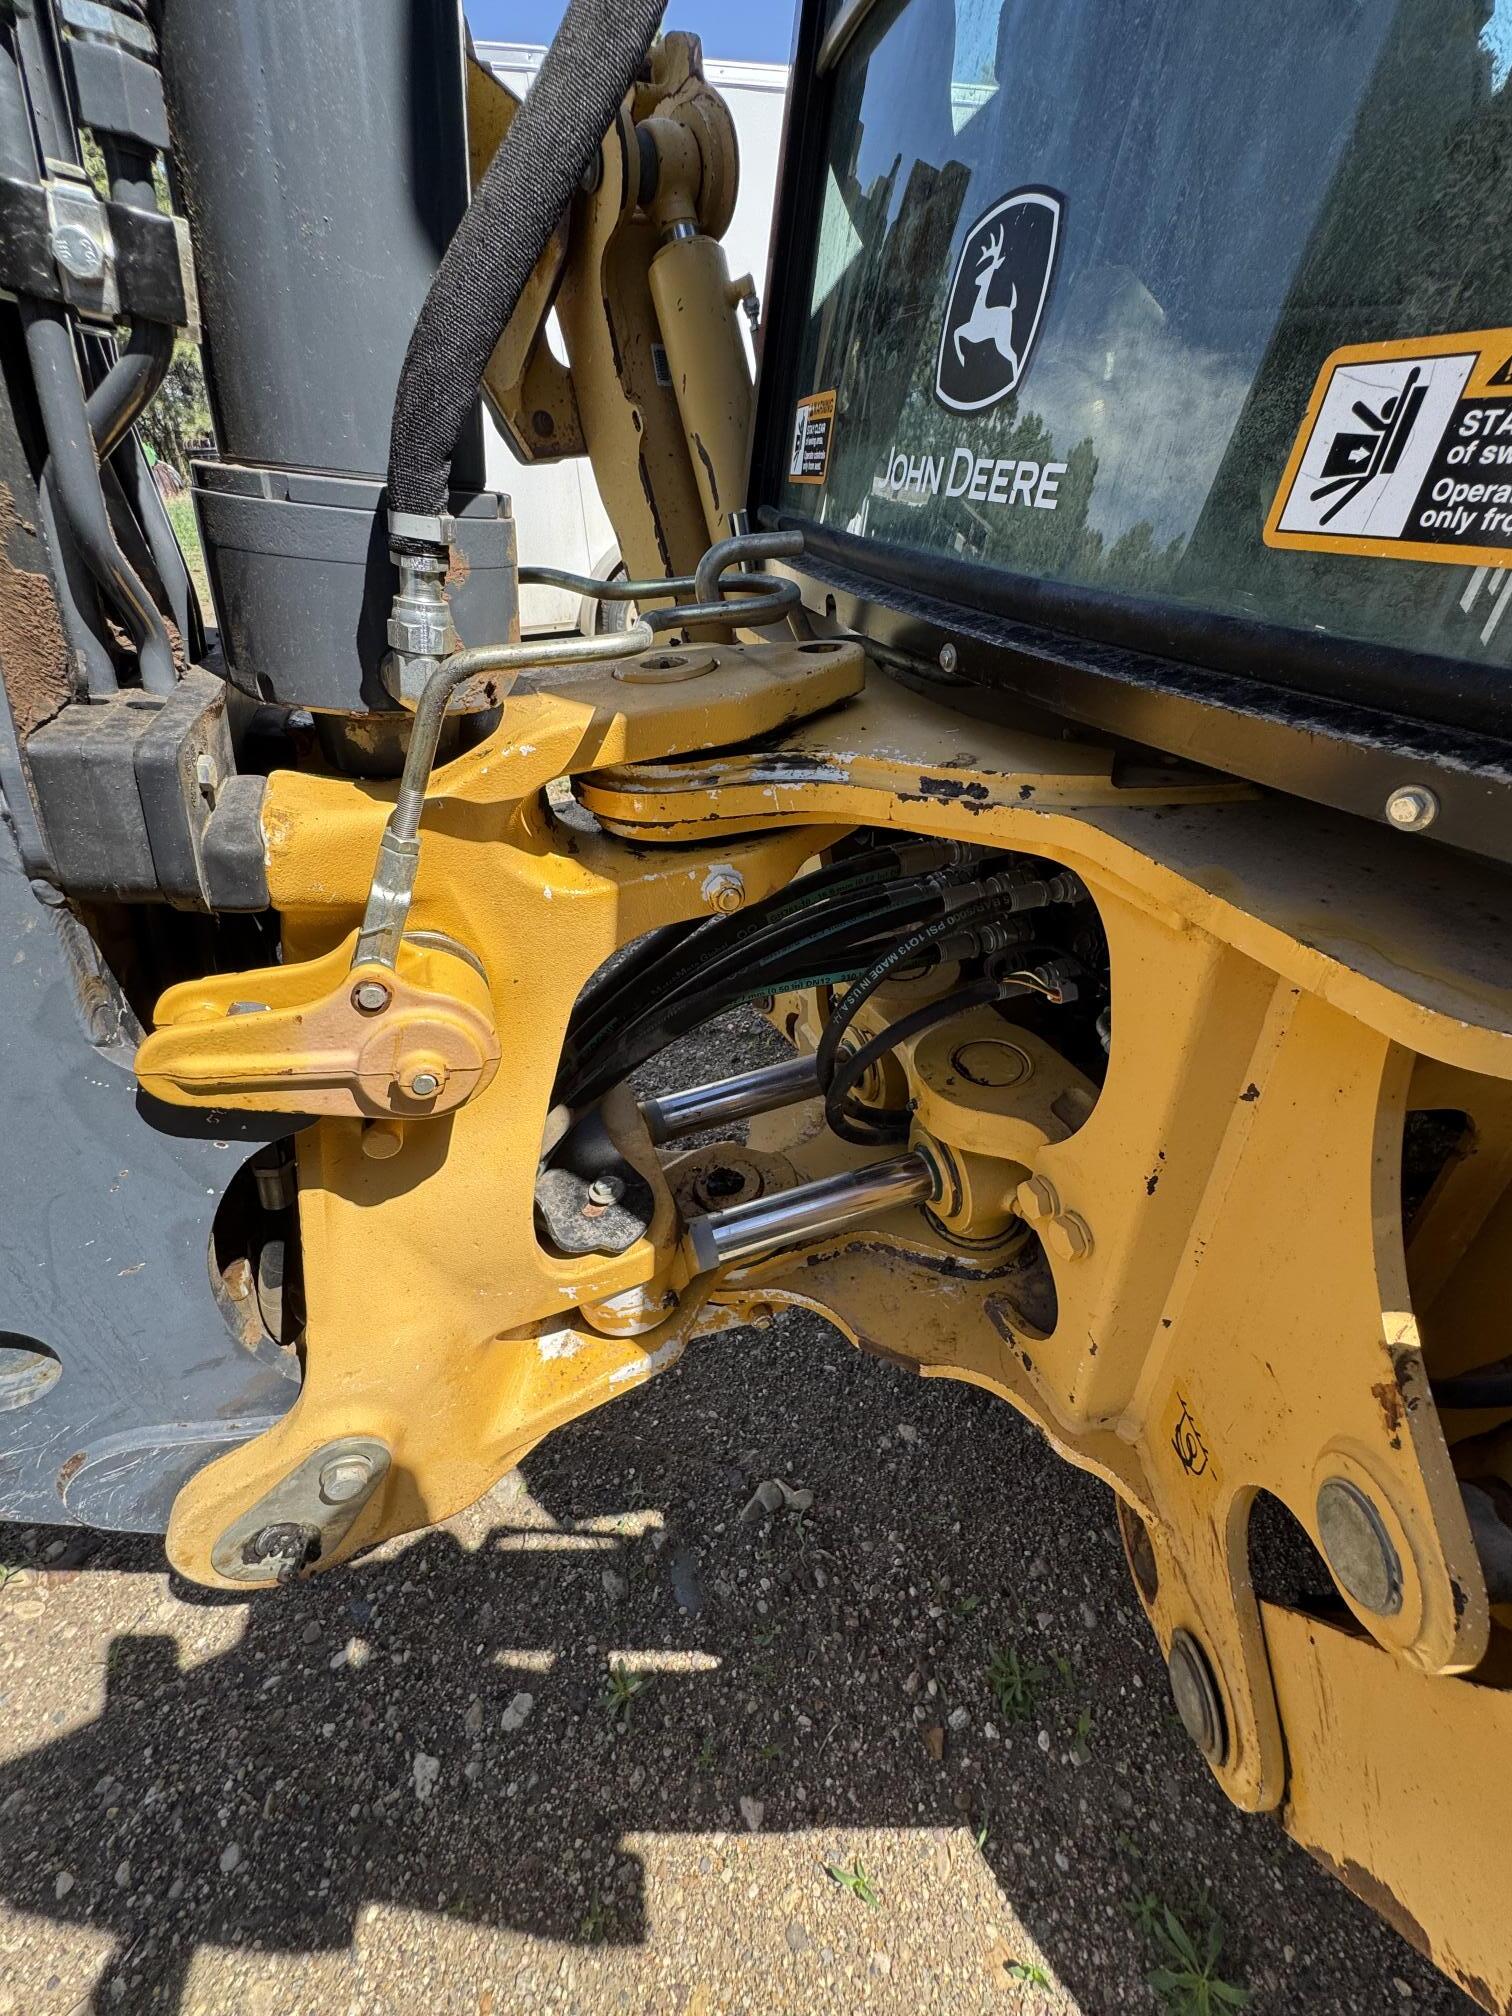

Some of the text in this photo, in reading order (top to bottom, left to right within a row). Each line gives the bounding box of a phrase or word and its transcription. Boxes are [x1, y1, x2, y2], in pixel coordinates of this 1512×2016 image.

[1446, 440, 1480, 465] of
[879, 445, 1068, 510] JOHN DEERE
[1431, 477, 1512, 507] Opera
[1419, 506, 1479, 535] only
[870, 950, 899, 981] MADE
[859, 977, 873, 992] IN
